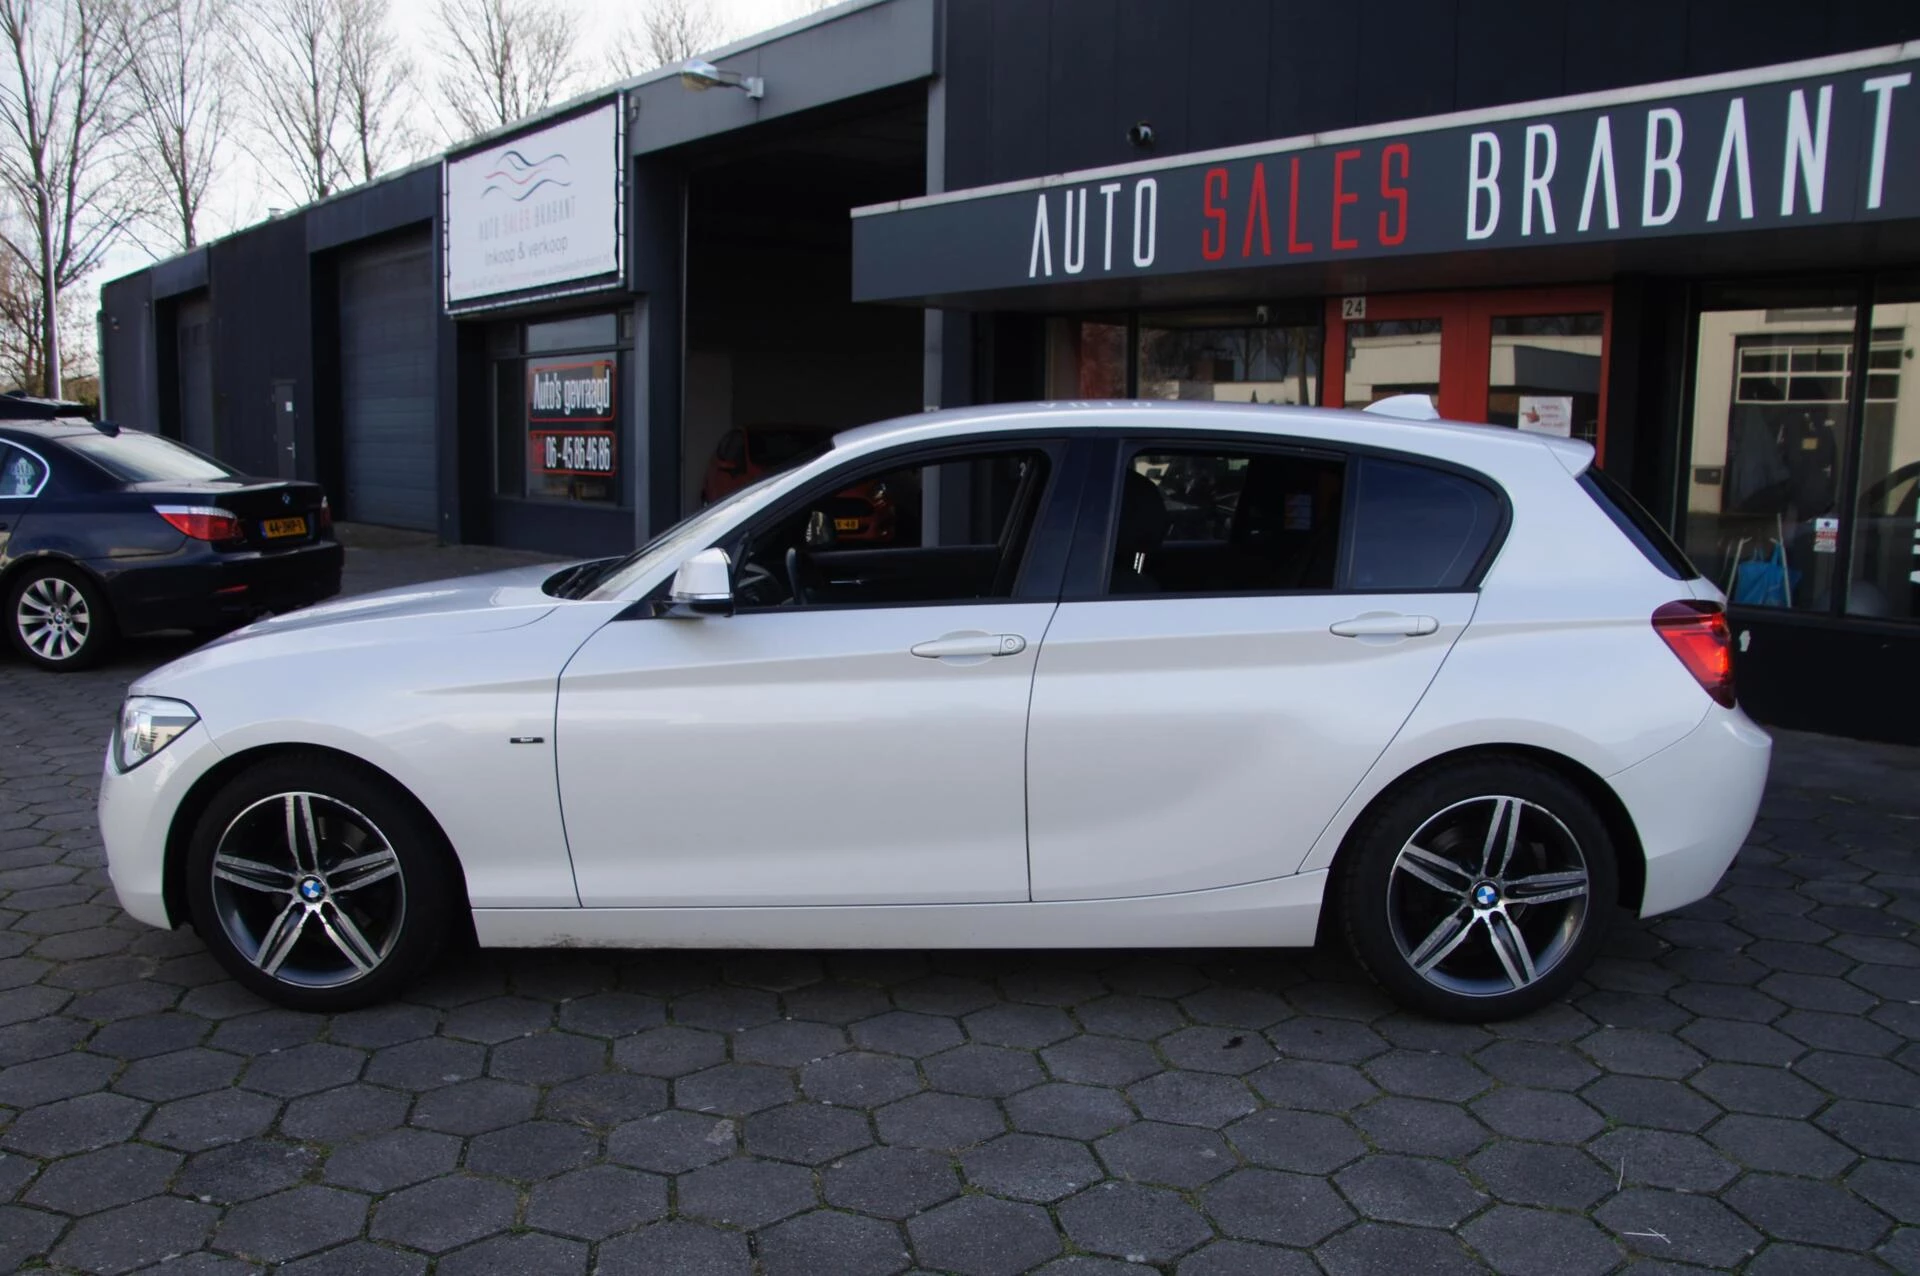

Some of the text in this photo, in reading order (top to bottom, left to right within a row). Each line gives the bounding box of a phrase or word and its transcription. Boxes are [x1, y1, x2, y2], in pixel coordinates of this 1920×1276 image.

[1028, 71, 1912, 279] AUTO SALES BRABANT
[1345, 299, 1363, 317] 24
[533, 368, 610, 415] Auto's gevraagd
